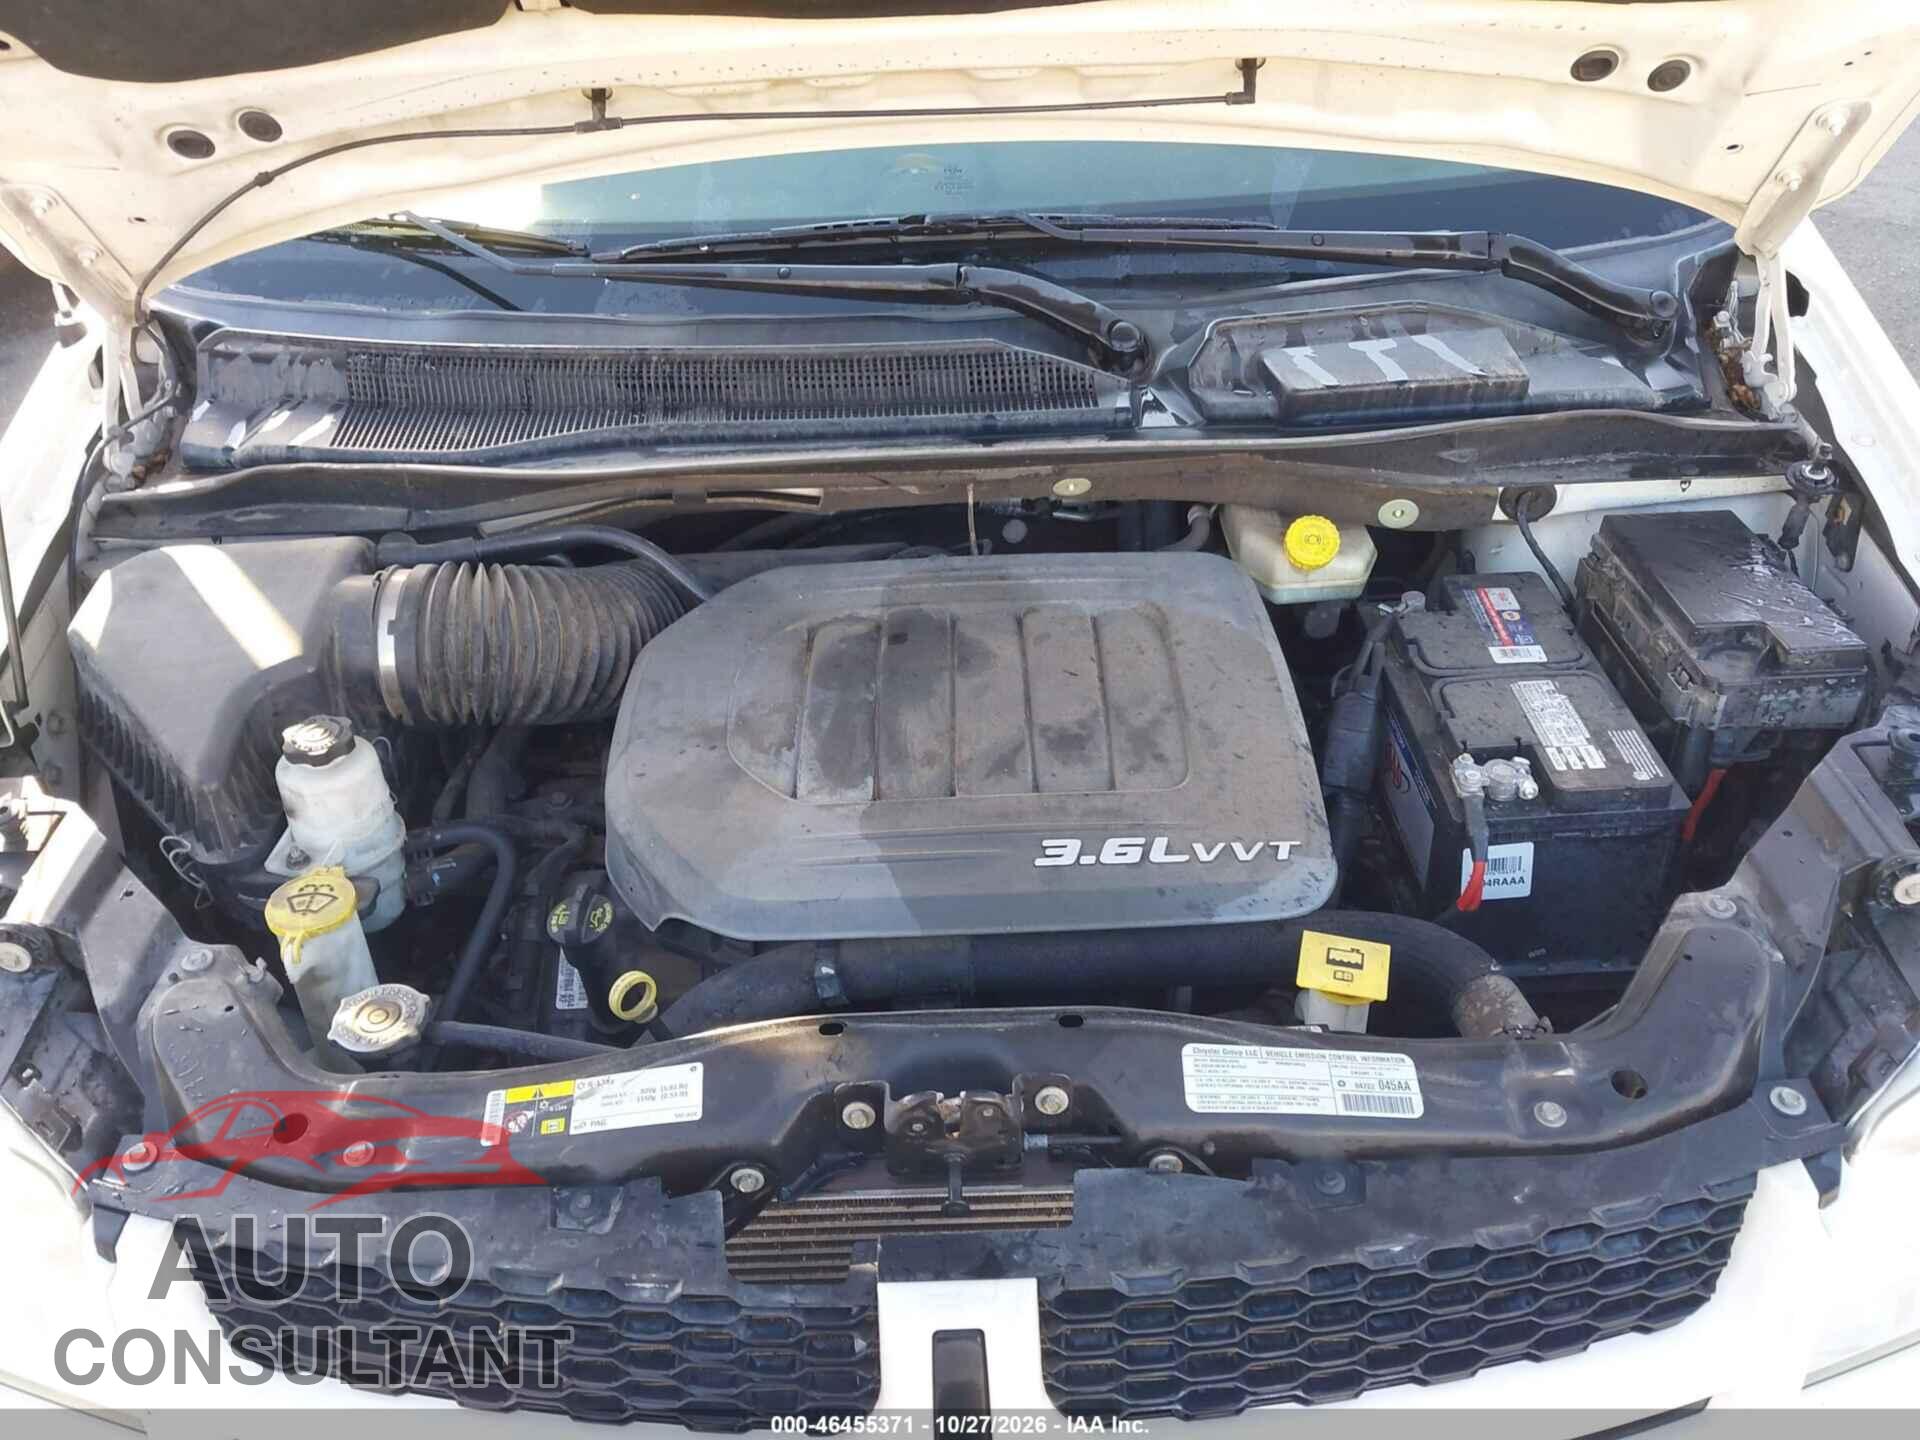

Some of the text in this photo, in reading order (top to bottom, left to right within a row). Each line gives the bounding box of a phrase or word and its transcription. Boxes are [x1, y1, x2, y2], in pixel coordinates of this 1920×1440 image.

[1222, 1048, 1243, 1057] Group
[1265, 1050, 1292, 1058] VEHICLE
[1295, 1051, 1326, 1060] EMISSION
[1328, 1053, 1359, 1062] CONTROL
[1360, 1055, 1406, 1064] INFORMATION
[1378, 1079, 1412, 1092] 045AA
